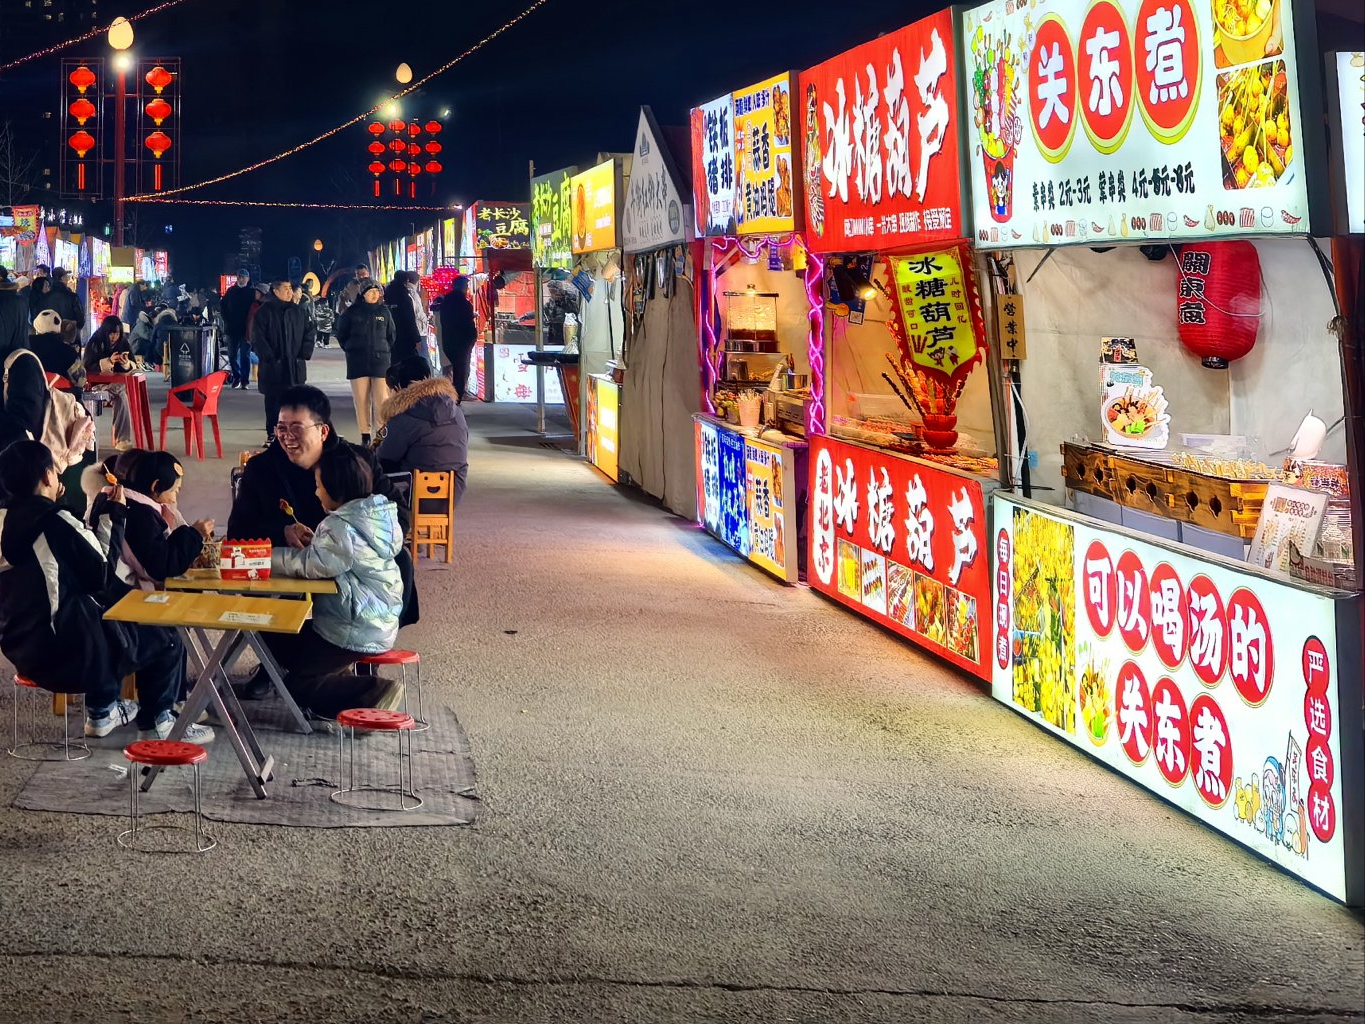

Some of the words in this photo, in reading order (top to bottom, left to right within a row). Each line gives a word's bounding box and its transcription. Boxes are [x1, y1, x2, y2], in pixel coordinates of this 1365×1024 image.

[1036, 3, 1189, 130] 关东煮
[707, 105, 730, 153] 铁板
[752, 122, 770, 172] 蒜香
[822, 27, 950, 207] 冰糖葫芦
[551, 171, 572, 242] 豆腐
[707, 151, 733, 196] 猪排
[1058, 175, 1092, 207] 2元-3元
[478, 207, 522, 222] 老长沙
[495, 219, 530, 237] 豆腐
[901, 284, 919, 331] 酸甜可口
[909, 256, 957, 349] 冰糖葫芦
[949, 277, 968, 325] 儿时回忆
[818, 459, 830, 574] 老北京
[834, 458, 978, 587] 冰糖葫芦
[1086, 557, 1267, 693] 可以喝汤的
[1119, 673, 1227, 801] 关东煮
[1307, 649, 1332, 832] 严选食材
